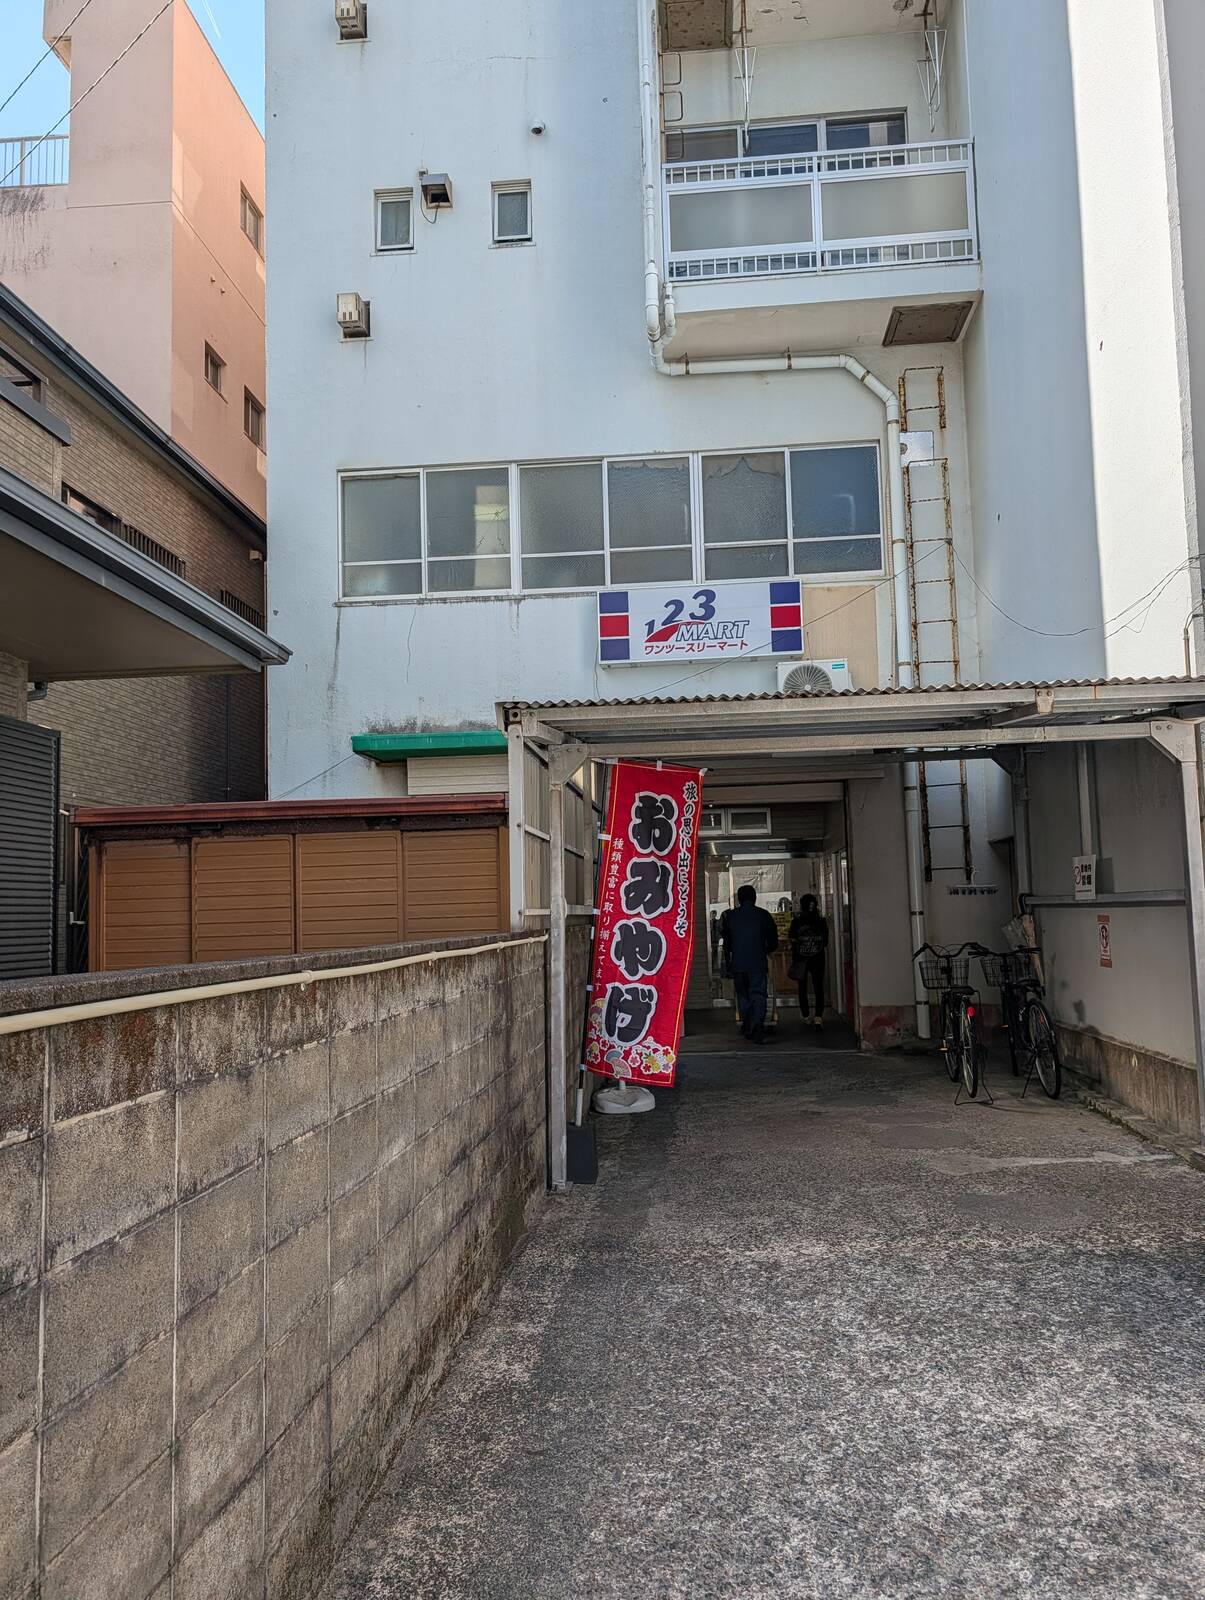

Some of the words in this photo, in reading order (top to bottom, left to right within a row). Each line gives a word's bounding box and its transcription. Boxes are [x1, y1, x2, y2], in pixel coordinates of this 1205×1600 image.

[644, 589, 717, 637] 123
[676, 620, 750, 642] MART
[644, 640, 749, 655] ワンツースリーマート
[594, 837, 624, 991] 種類豊富に取り揃えてます
[602, 791, 678, 1046] おみやげ
